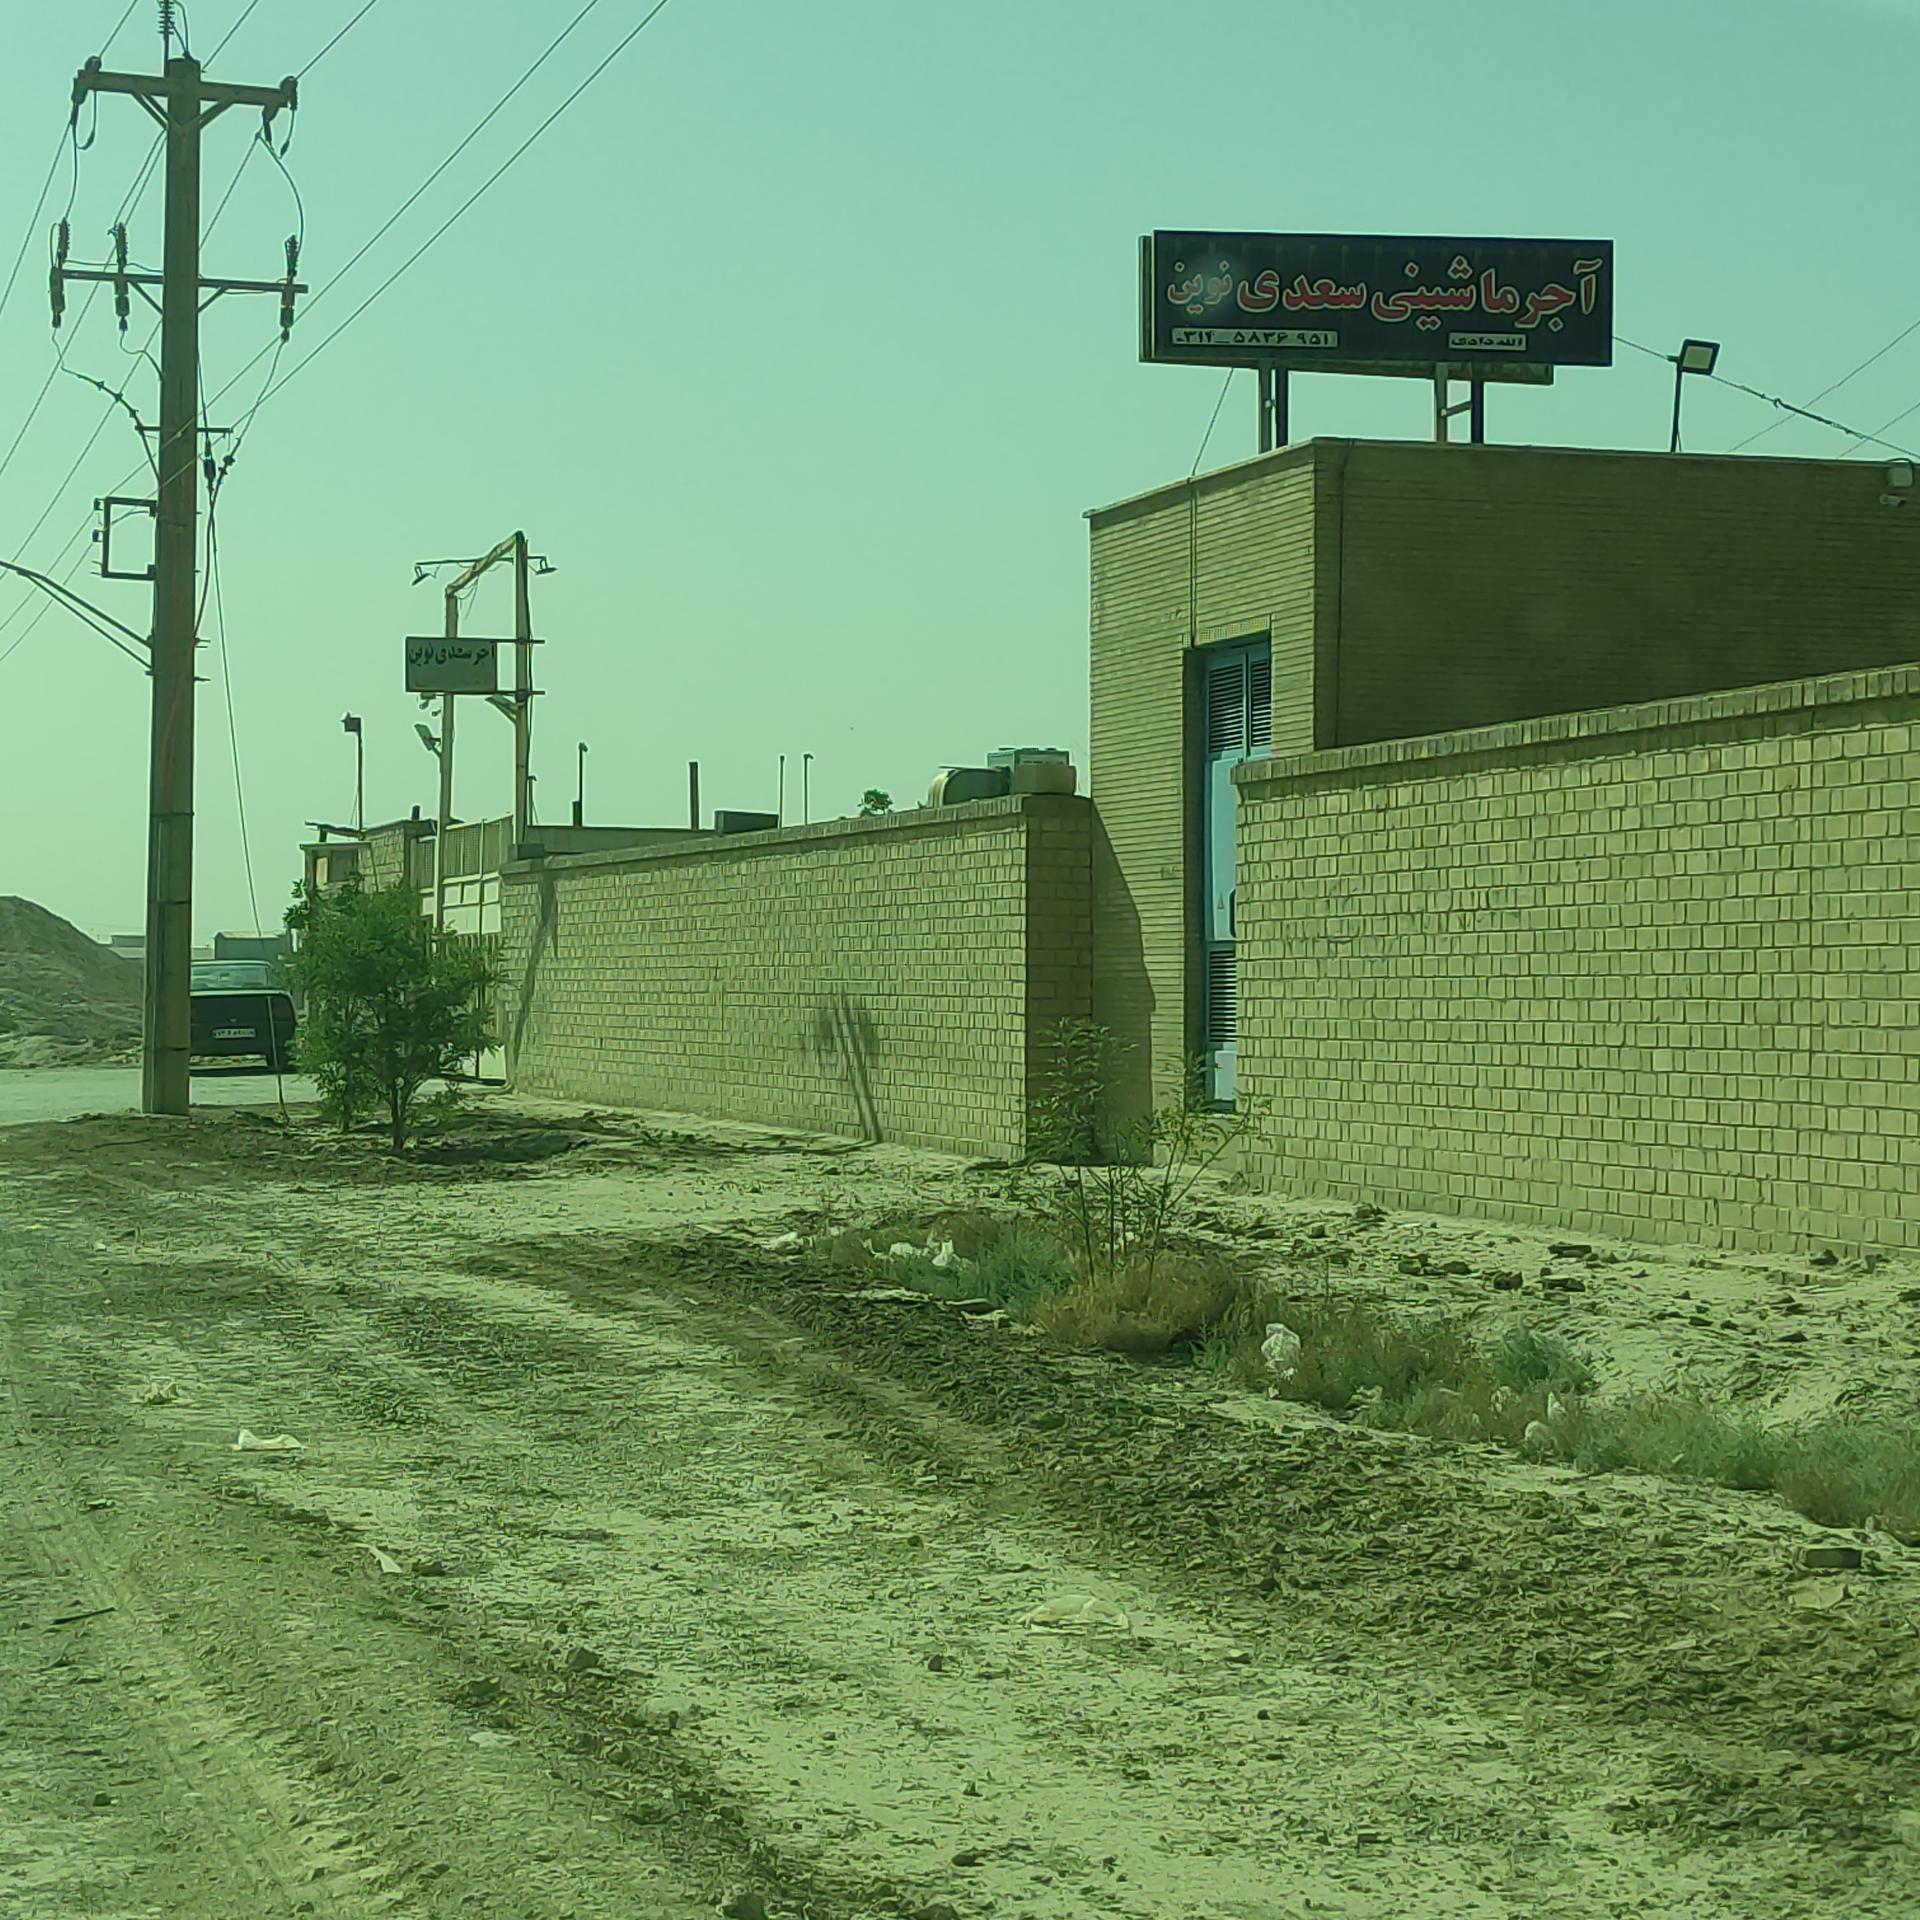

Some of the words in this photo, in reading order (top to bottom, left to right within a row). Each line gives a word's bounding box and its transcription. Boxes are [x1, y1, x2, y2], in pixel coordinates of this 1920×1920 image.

[1167, 260, 1233, 315] نوین
[1236, 269, 1368, 313] سعدی
[1371, 253, 1519, 331] ماشینی
[1513, 258, 1603, 333] آجر
